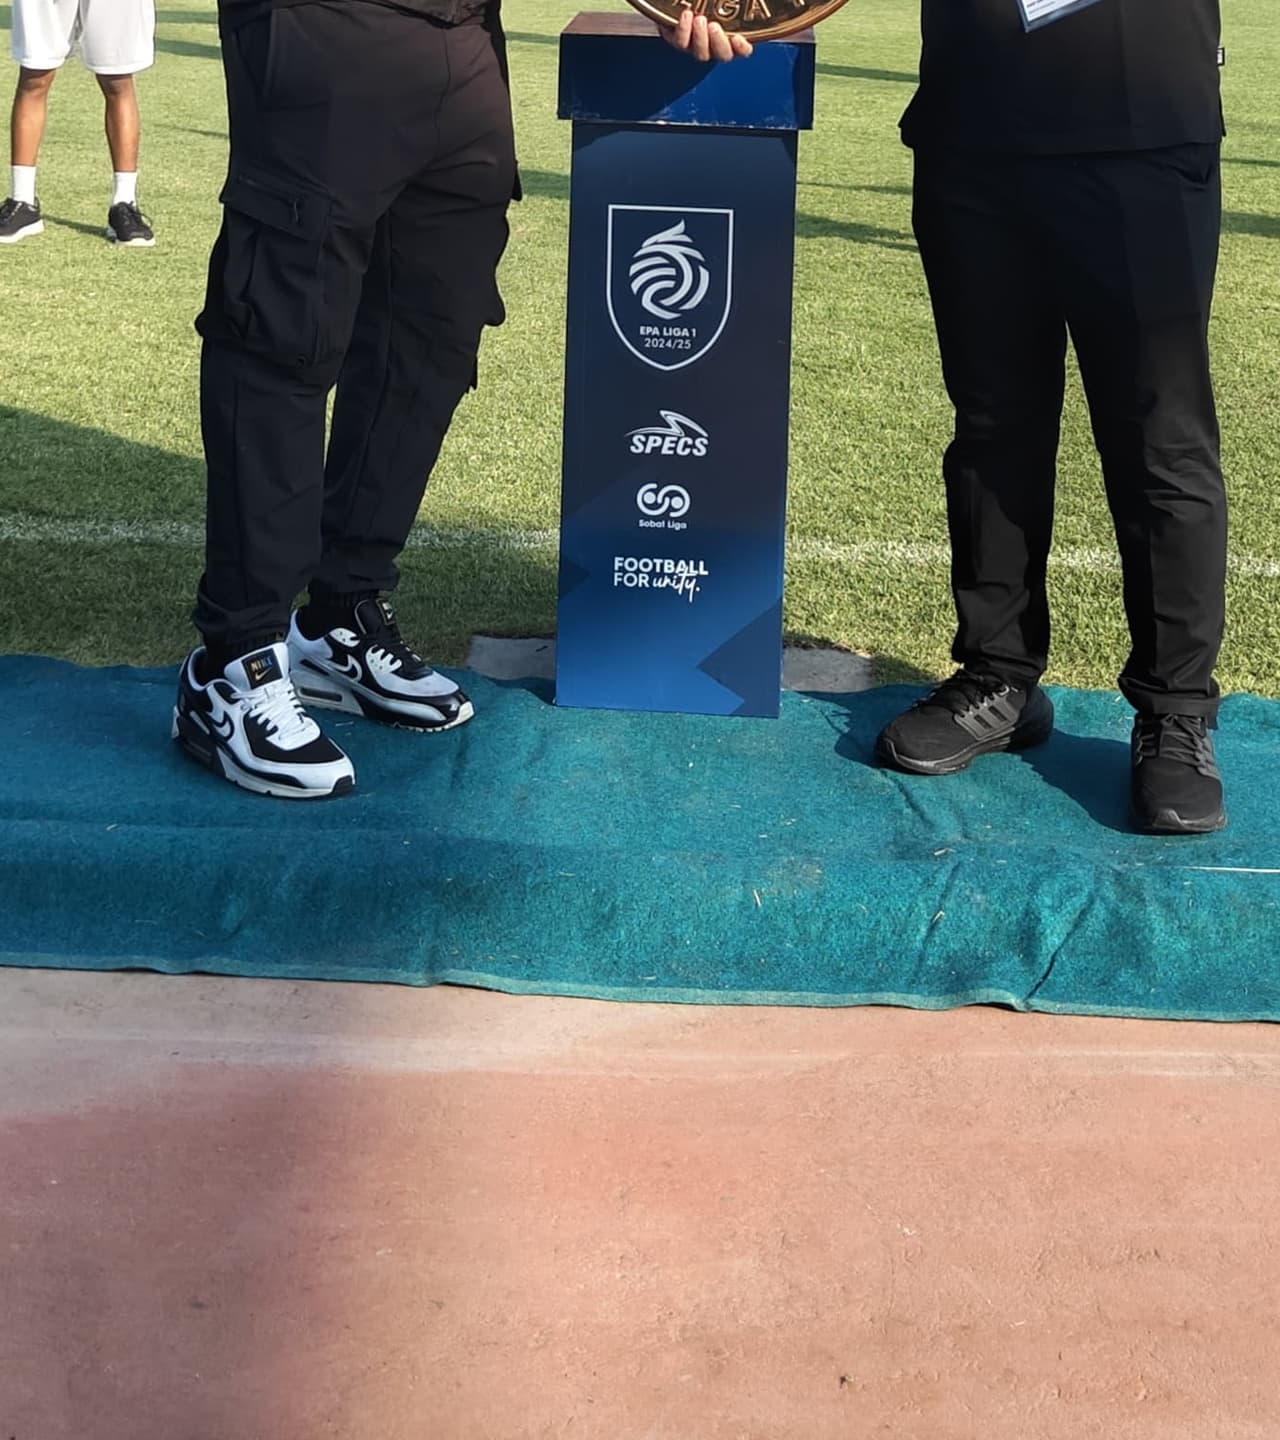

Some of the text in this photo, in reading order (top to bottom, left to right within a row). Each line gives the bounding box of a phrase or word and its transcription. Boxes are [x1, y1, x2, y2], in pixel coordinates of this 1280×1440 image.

[640, 326, 696, 338] EPA LIGA 1
[644, 338, 692, 349] 2024/25
[630, 434, 708, 457] SPECS
[639, 519, 687, 531] Sobat Liga
[614, 556, 709, 576] FOOTBALL
[614, 572, 650, 588] FOR
